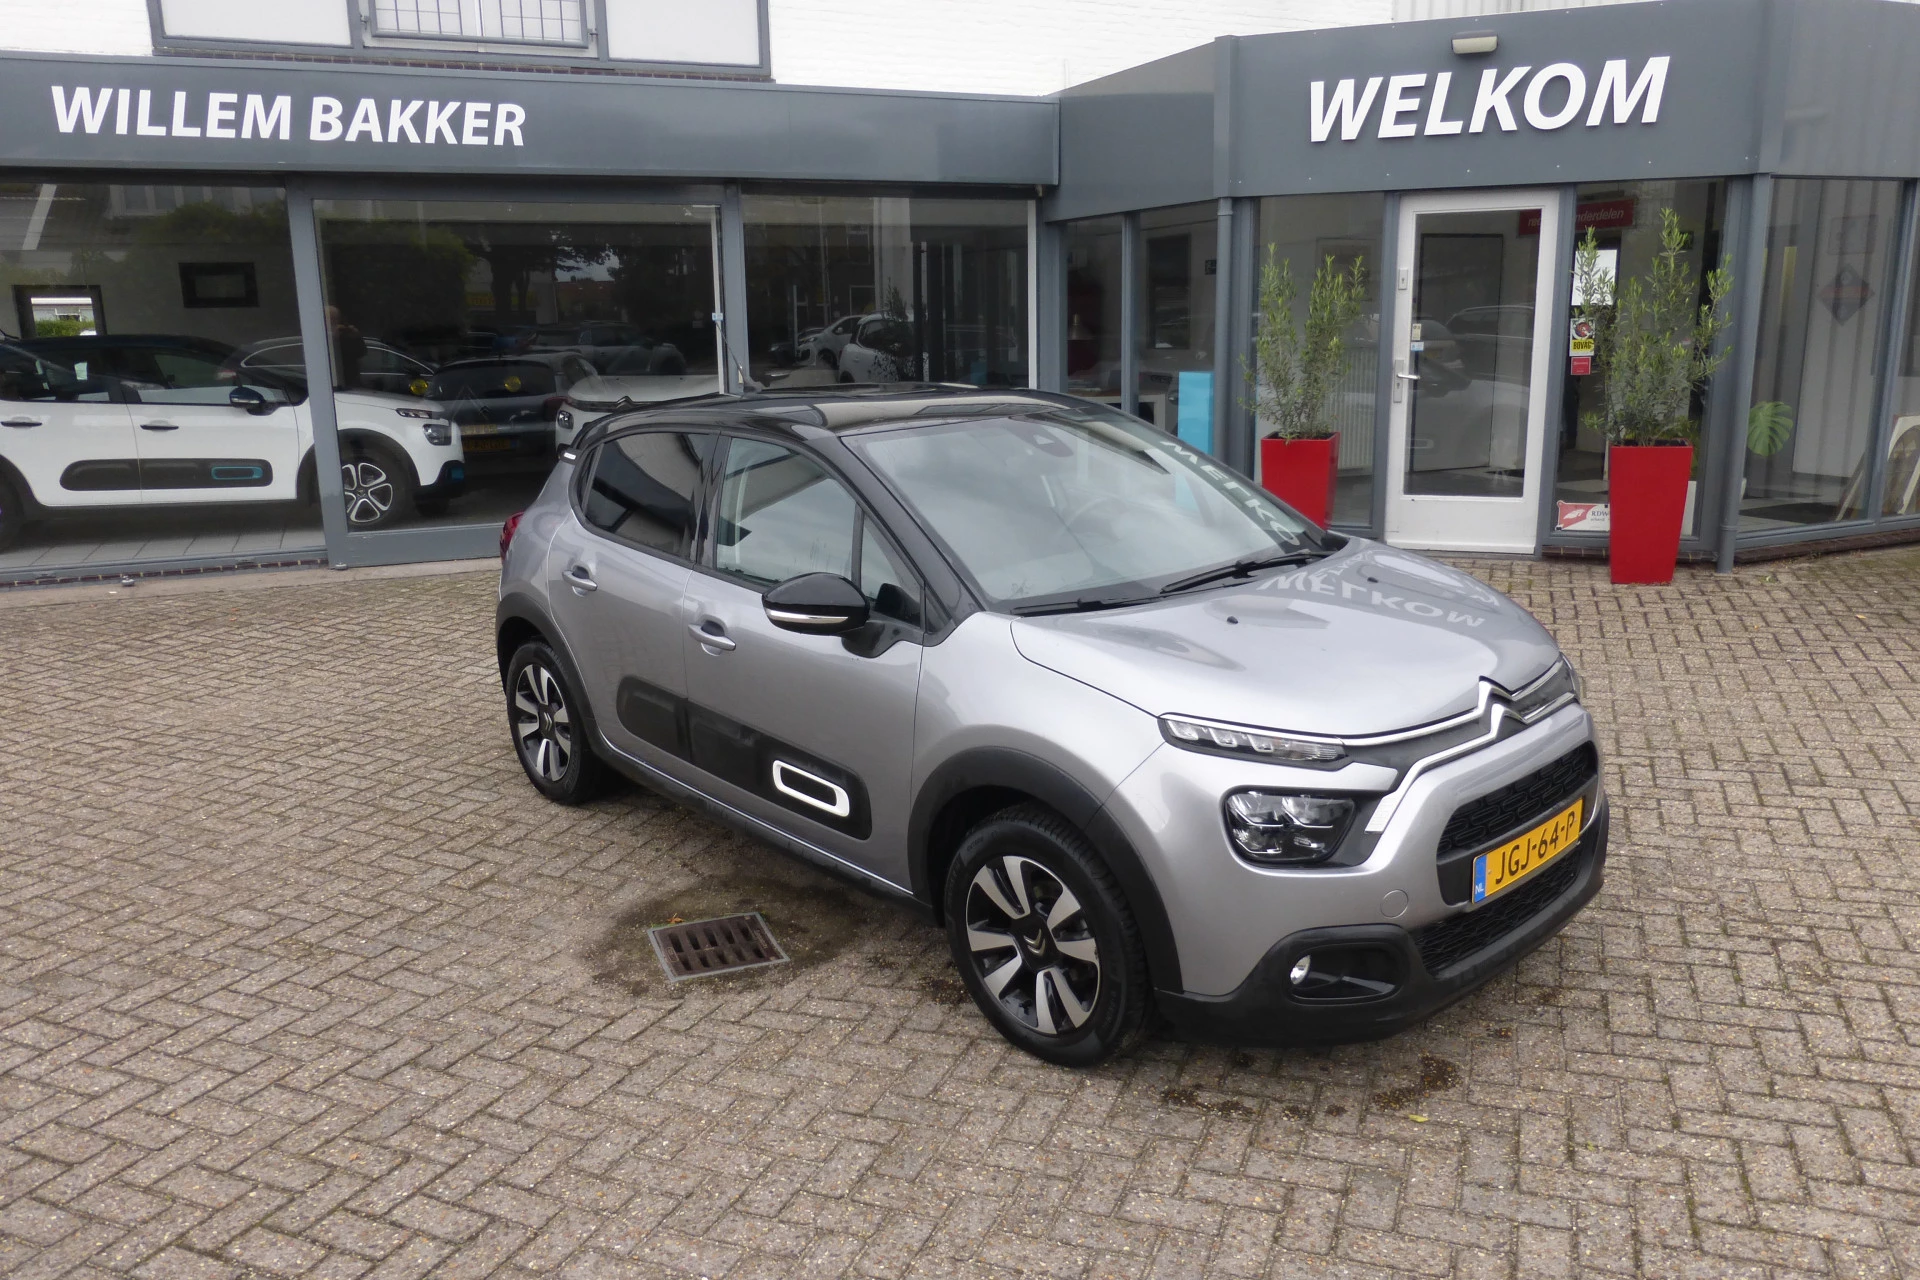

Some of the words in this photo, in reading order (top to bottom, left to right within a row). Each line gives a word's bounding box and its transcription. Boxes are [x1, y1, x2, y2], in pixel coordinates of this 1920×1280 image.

[51, 85, 291, 140] WILLEM
[309, 95, 527, 146] BAKKER
[1310, 55, 1671, 142] WELKOM
[1495, 810, 1575, 885] JGJ-64-P
[1475, 882, 1485, 894] NL
